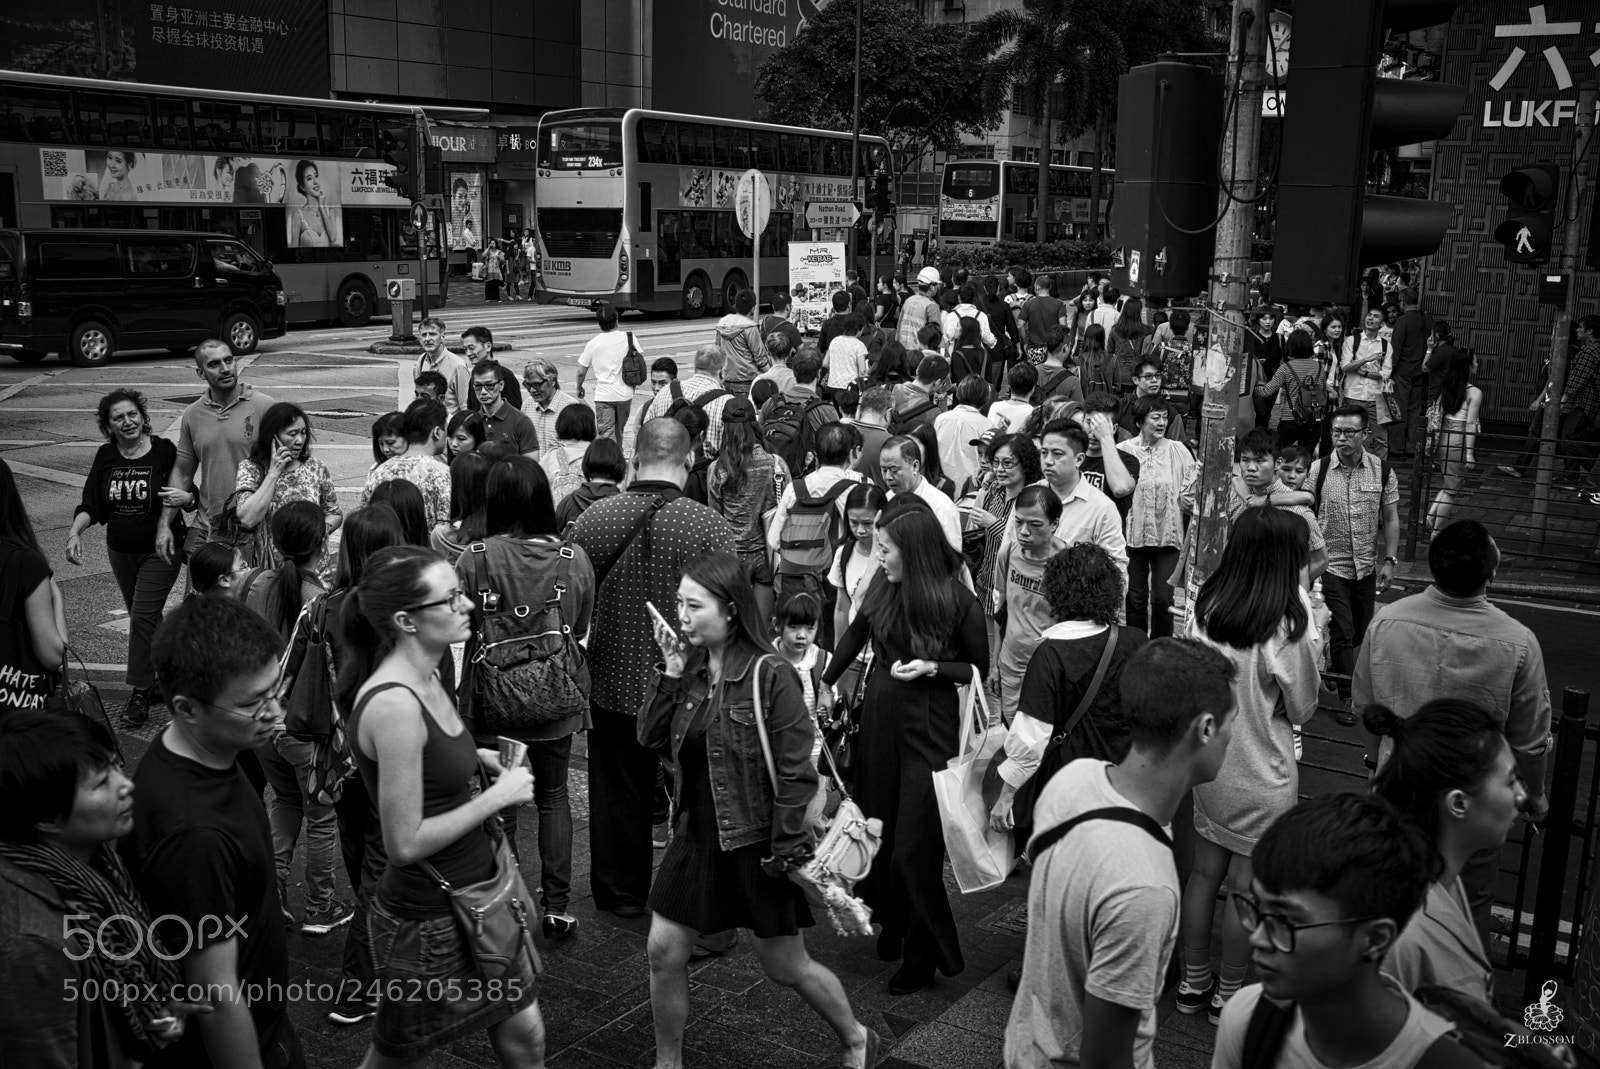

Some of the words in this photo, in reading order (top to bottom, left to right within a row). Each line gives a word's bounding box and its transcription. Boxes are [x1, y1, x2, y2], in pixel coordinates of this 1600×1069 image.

[710, 12, 786, 48] Chartered
[968, 188, 974, 198] 6
[818, 205, 834, 213] Nathan
[834, 205, 846, 213] Road
[807, 254, 833, 263] KEBAB
[551, 260, 572, 271] KMB
[109, 479, 148, 500] NYC
[0, 687, 48, 710] ONDAY
